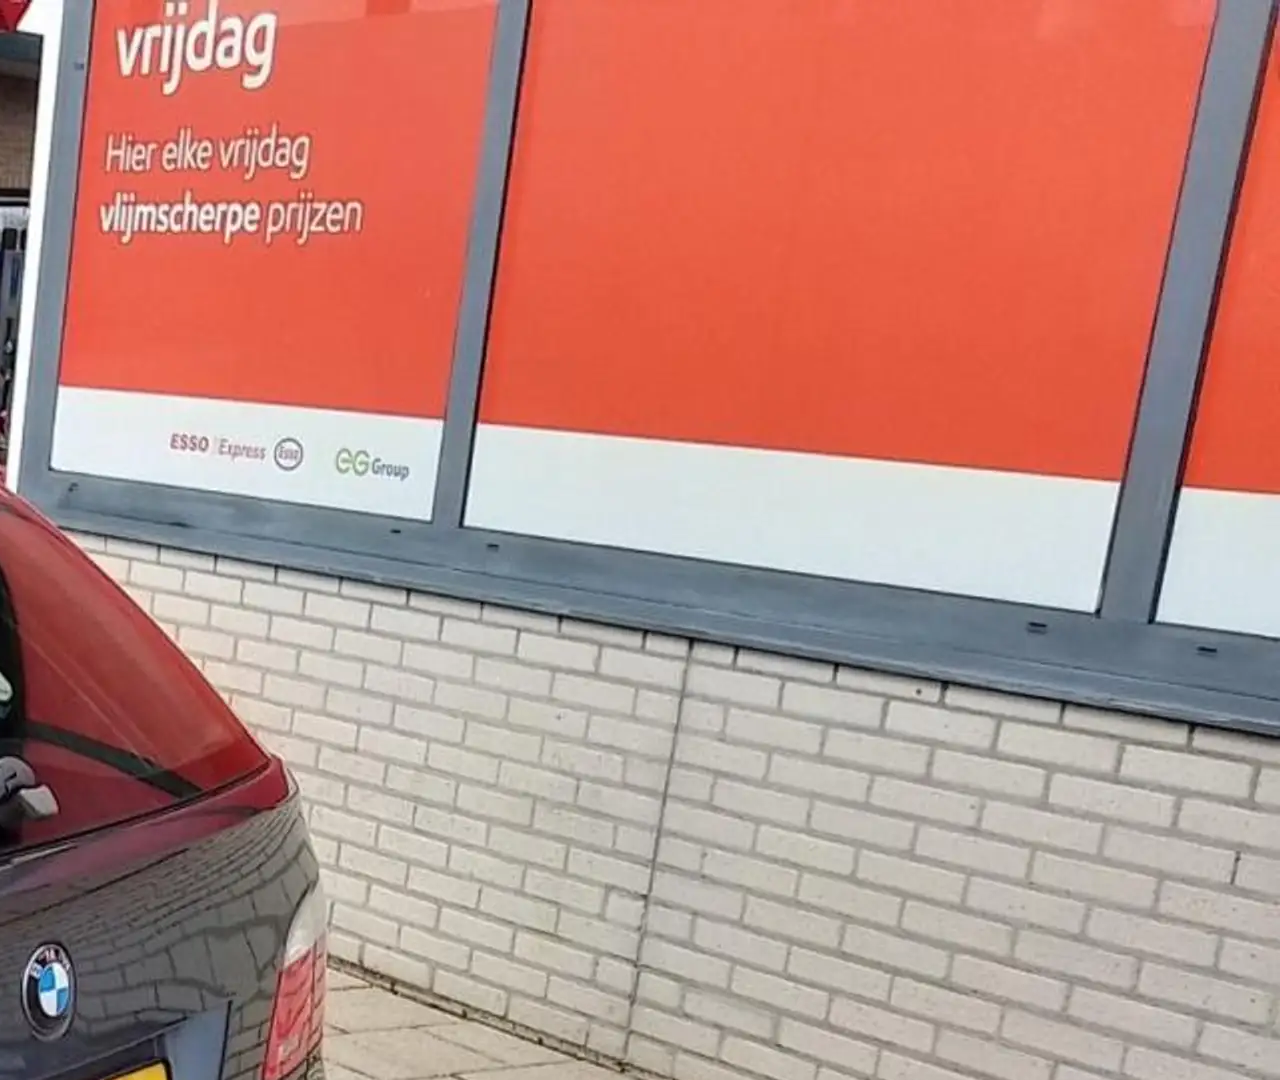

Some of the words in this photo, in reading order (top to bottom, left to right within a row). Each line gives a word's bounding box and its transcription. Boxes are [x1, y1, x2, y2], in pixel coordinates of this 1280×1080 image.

[116, 0, 277, 95] vrijdag
[105, 133, 157, 173] Hier
[161, 128, 213, 172] elke
[219, 123, 311, 180] vrijdag
[99, 189, 260, 245] vlijmscherpe
[265, 191, 363, 245] prijzen
[170, 433, 209, 452] ESSO
[217, 438, 266, 463] Express
[371, 457, 410, 481] Group
